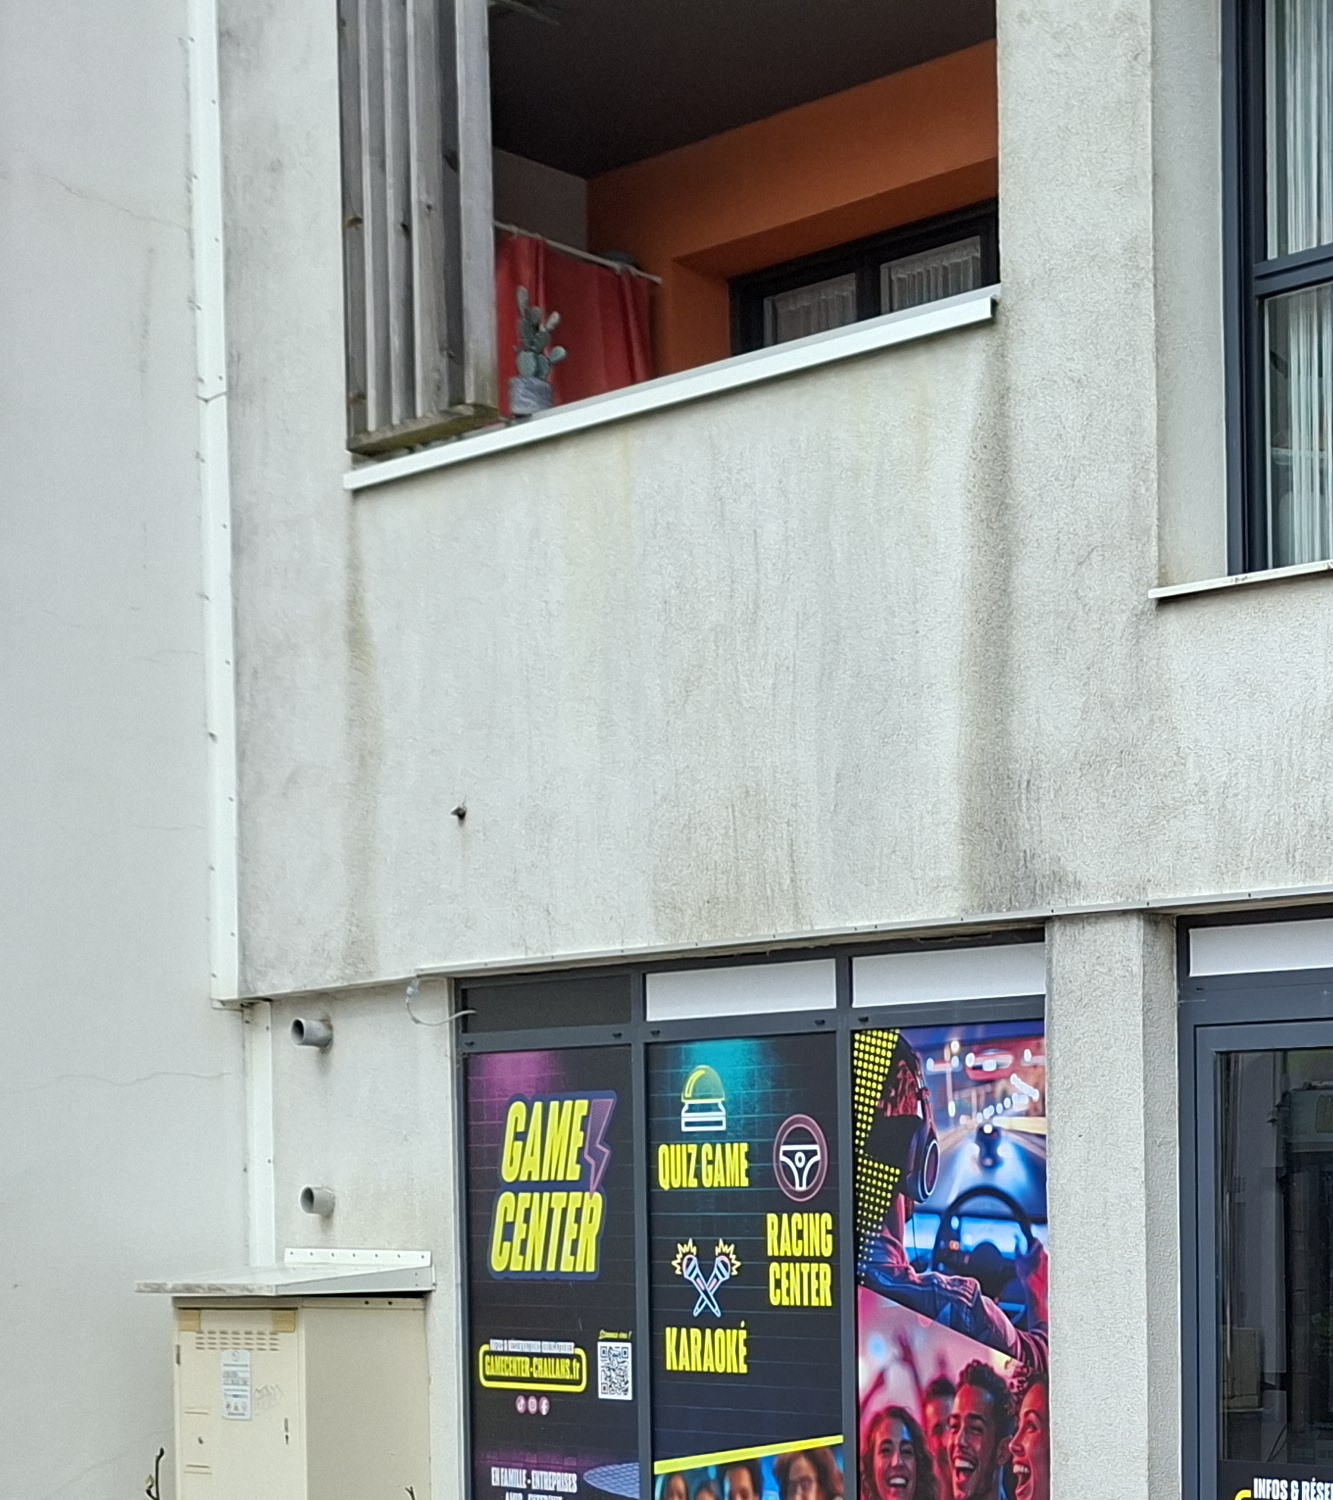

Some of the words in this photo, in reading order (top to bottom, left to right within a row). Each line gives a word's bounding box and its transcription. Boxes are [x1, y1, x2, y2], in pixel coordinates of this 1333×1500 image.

[502, 1099, 589, 1182] GAME
[658, 1143, 698, 1191] QUIZ
[701, 1142, 749, 1188] GAME
[491, 1191, 602, 1272] CENTER
[766, 1212, 833, 1257] RACING
[768, 1262, 833, 1307] CENTER
[484, 1354, 581, 1380] GAMECENTER-CHALLANS.fr
[665, 1320, 748, 1374] KARAOKÉ
[500, 1467, 527, 1489] FAMILLE
[1253, 1477, 1288, 1500] INFOS
